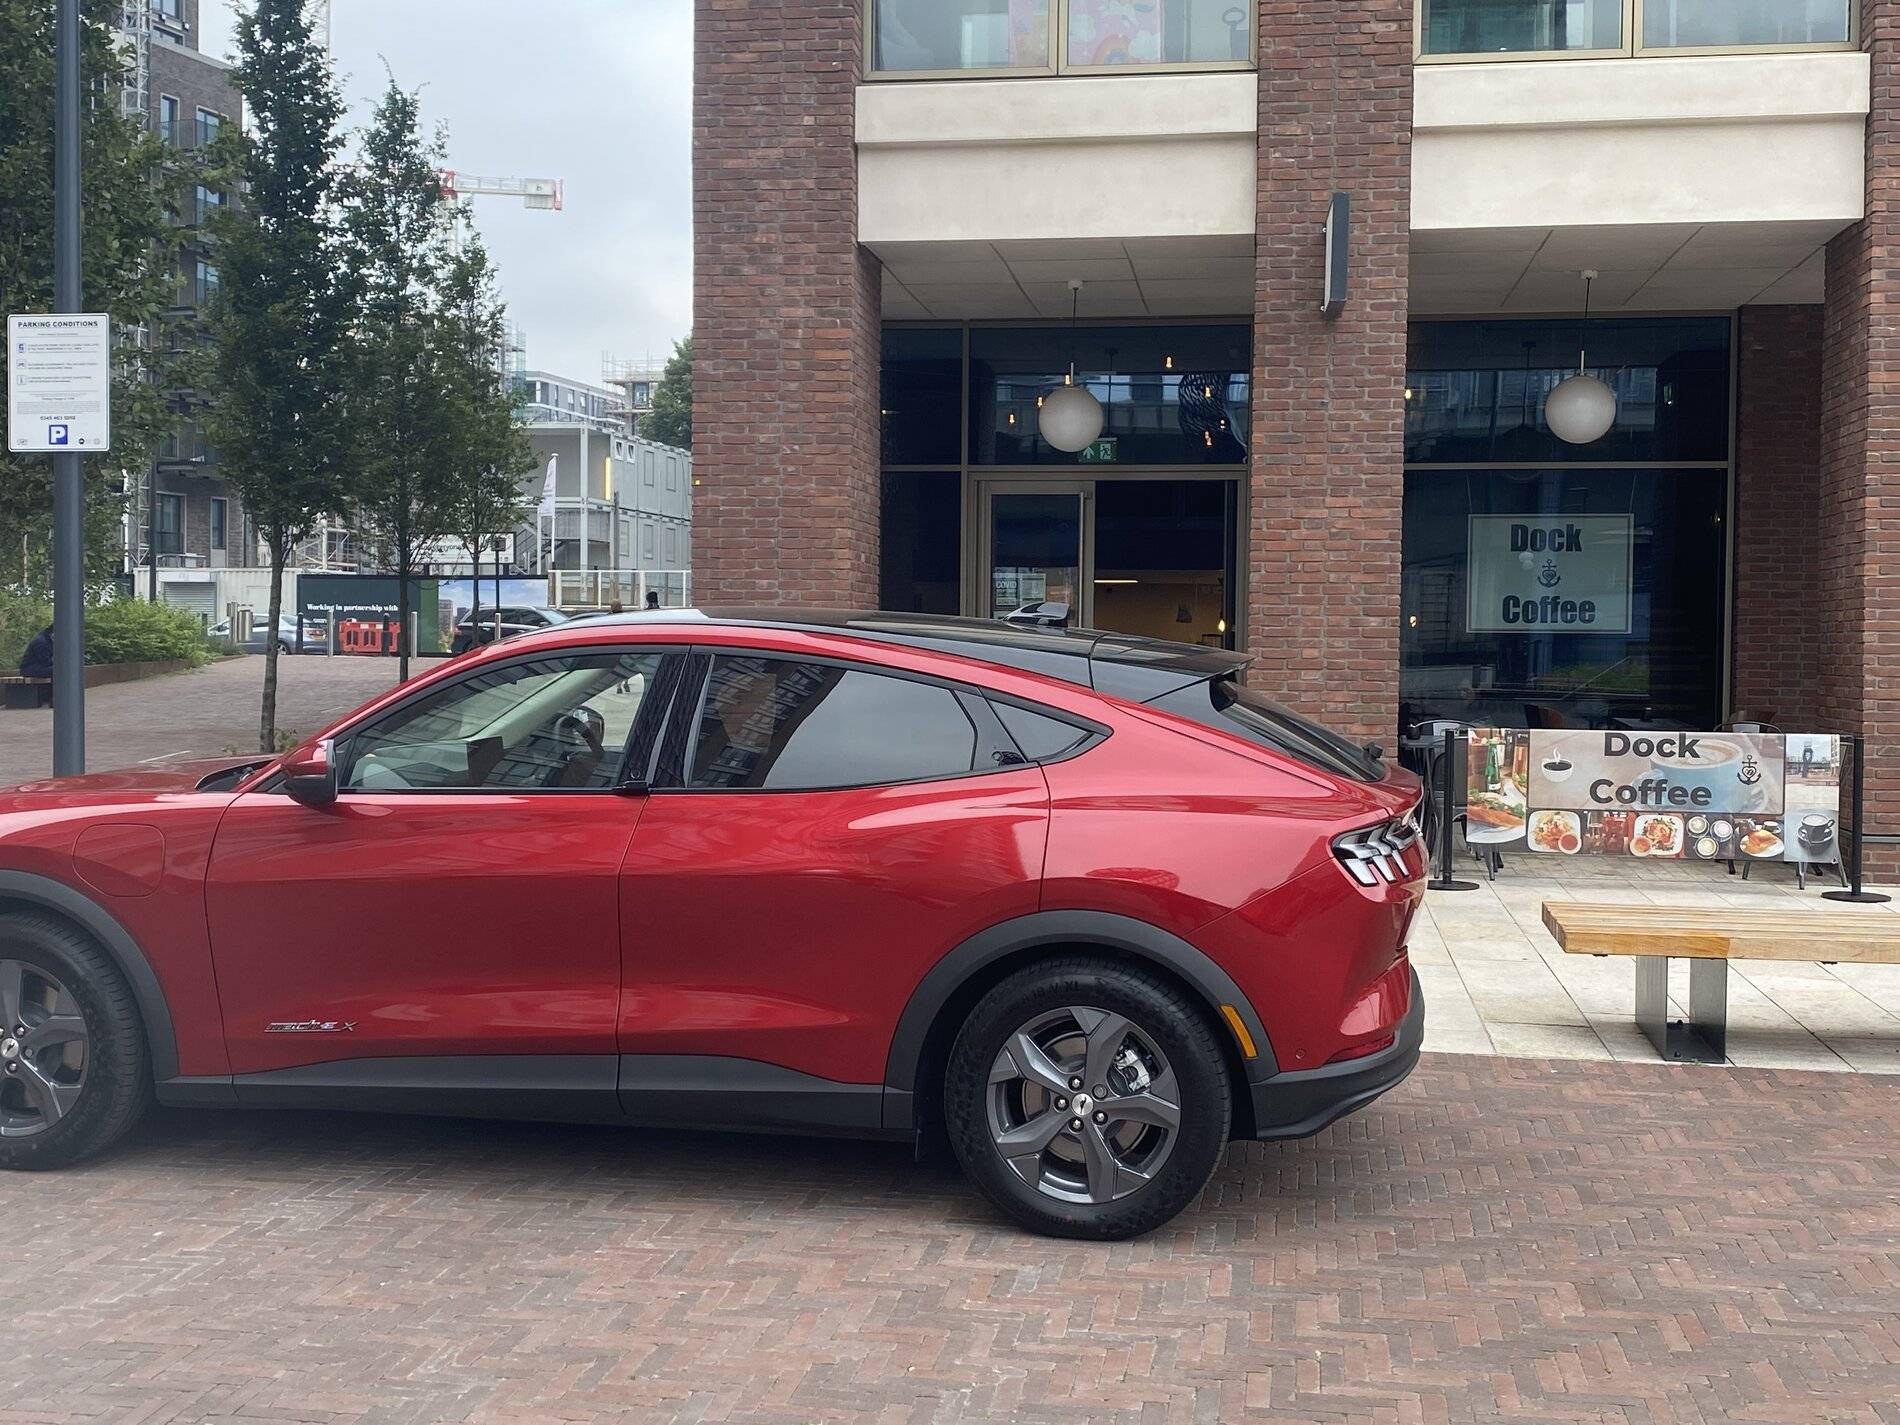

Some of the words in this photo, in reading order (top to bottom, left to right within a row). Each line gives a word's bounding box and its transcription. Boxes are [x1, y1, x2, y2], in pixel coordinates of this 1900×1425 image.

[50, 426, 66, 444] P
[1510, 524, 1583, 552] Dock
[307, 603, 335, 612] Working
[335, 603, 343, 611] in
[343, 604, 383, 613] partnership
[1502, 595, 1596, 624] Coffee
[1604, 732, 1701, 758] Dock
[1589, 778, 1713, 806] Coffee
